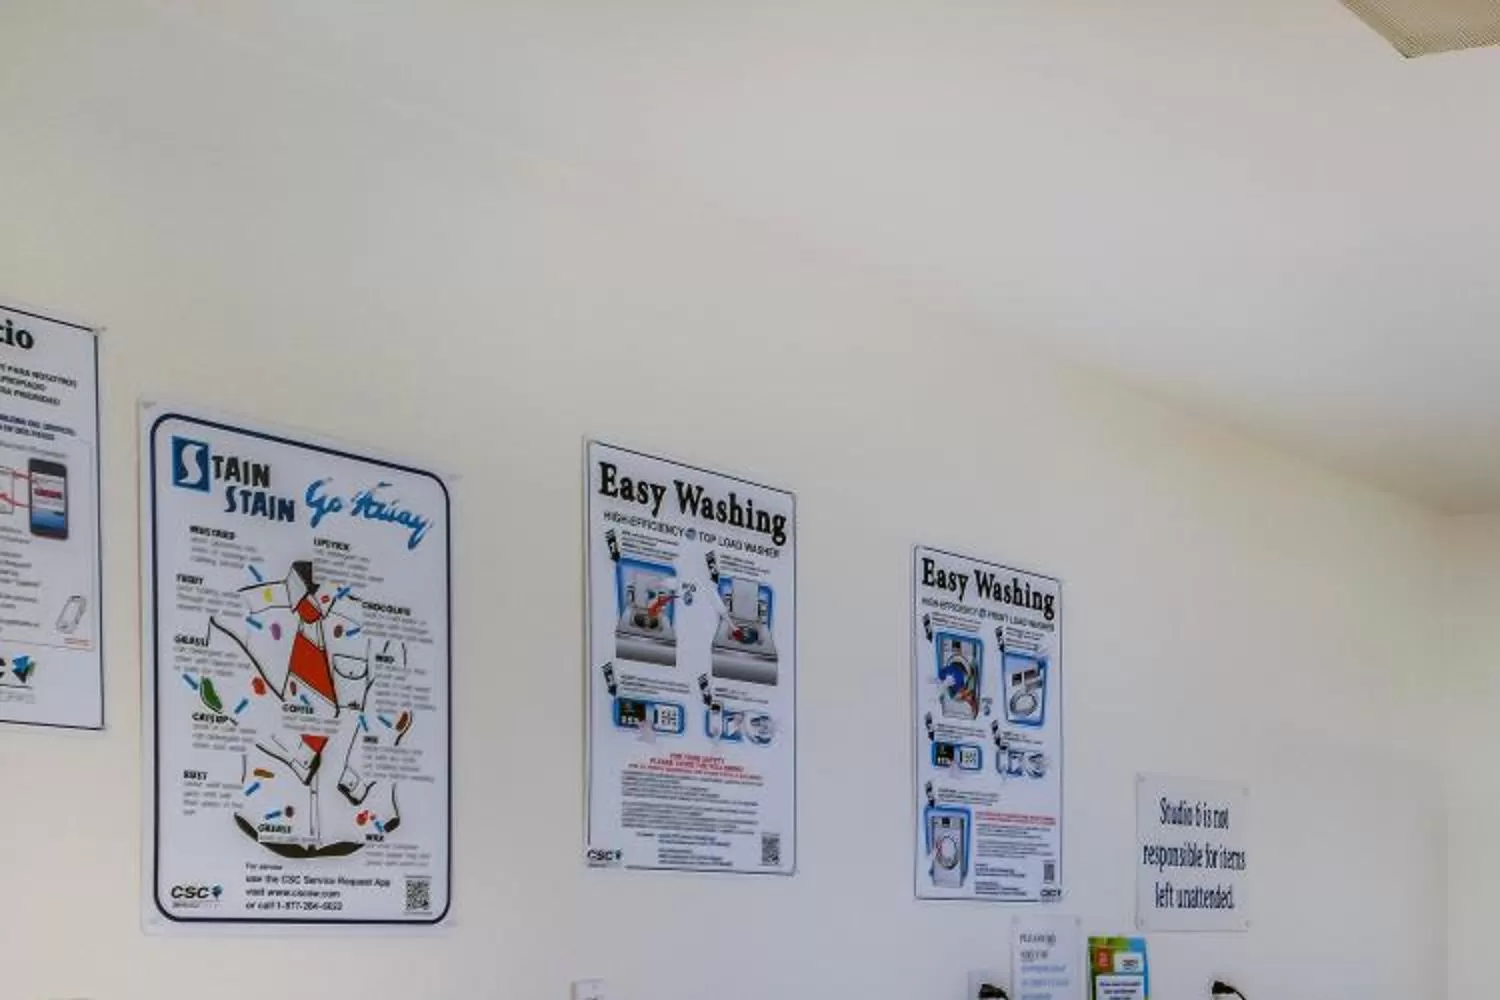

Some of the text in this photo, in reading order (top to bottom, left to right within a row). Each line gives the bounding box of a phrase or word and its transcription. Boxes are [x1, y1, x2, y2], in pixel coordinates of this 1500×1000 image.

[0, 319, 34, 350] io
[224, 485, 296, 523] STAIN
[305, 477, 344, 528] Go
[598, 461, 667, 518] Easy
[673, 479, 787, 546] Washing
[699, 531, 716, 543] TOP
[718, 537, 743, 551] LOAD
[744, 540, 780, 558] WASHER
[921, 557, 1055, 621] Easy Washing
[1159, 797, 1193, 826] Studio
[1203, 801, 1212, 829] is
[1214, 808, 1229, 830] not
[1143, 842, 1247, 873] responsible for items
[171, 885, 210, 899] CSC
[303, 876, 336, 886] Service
[1155, 881, 1174, 909] left
